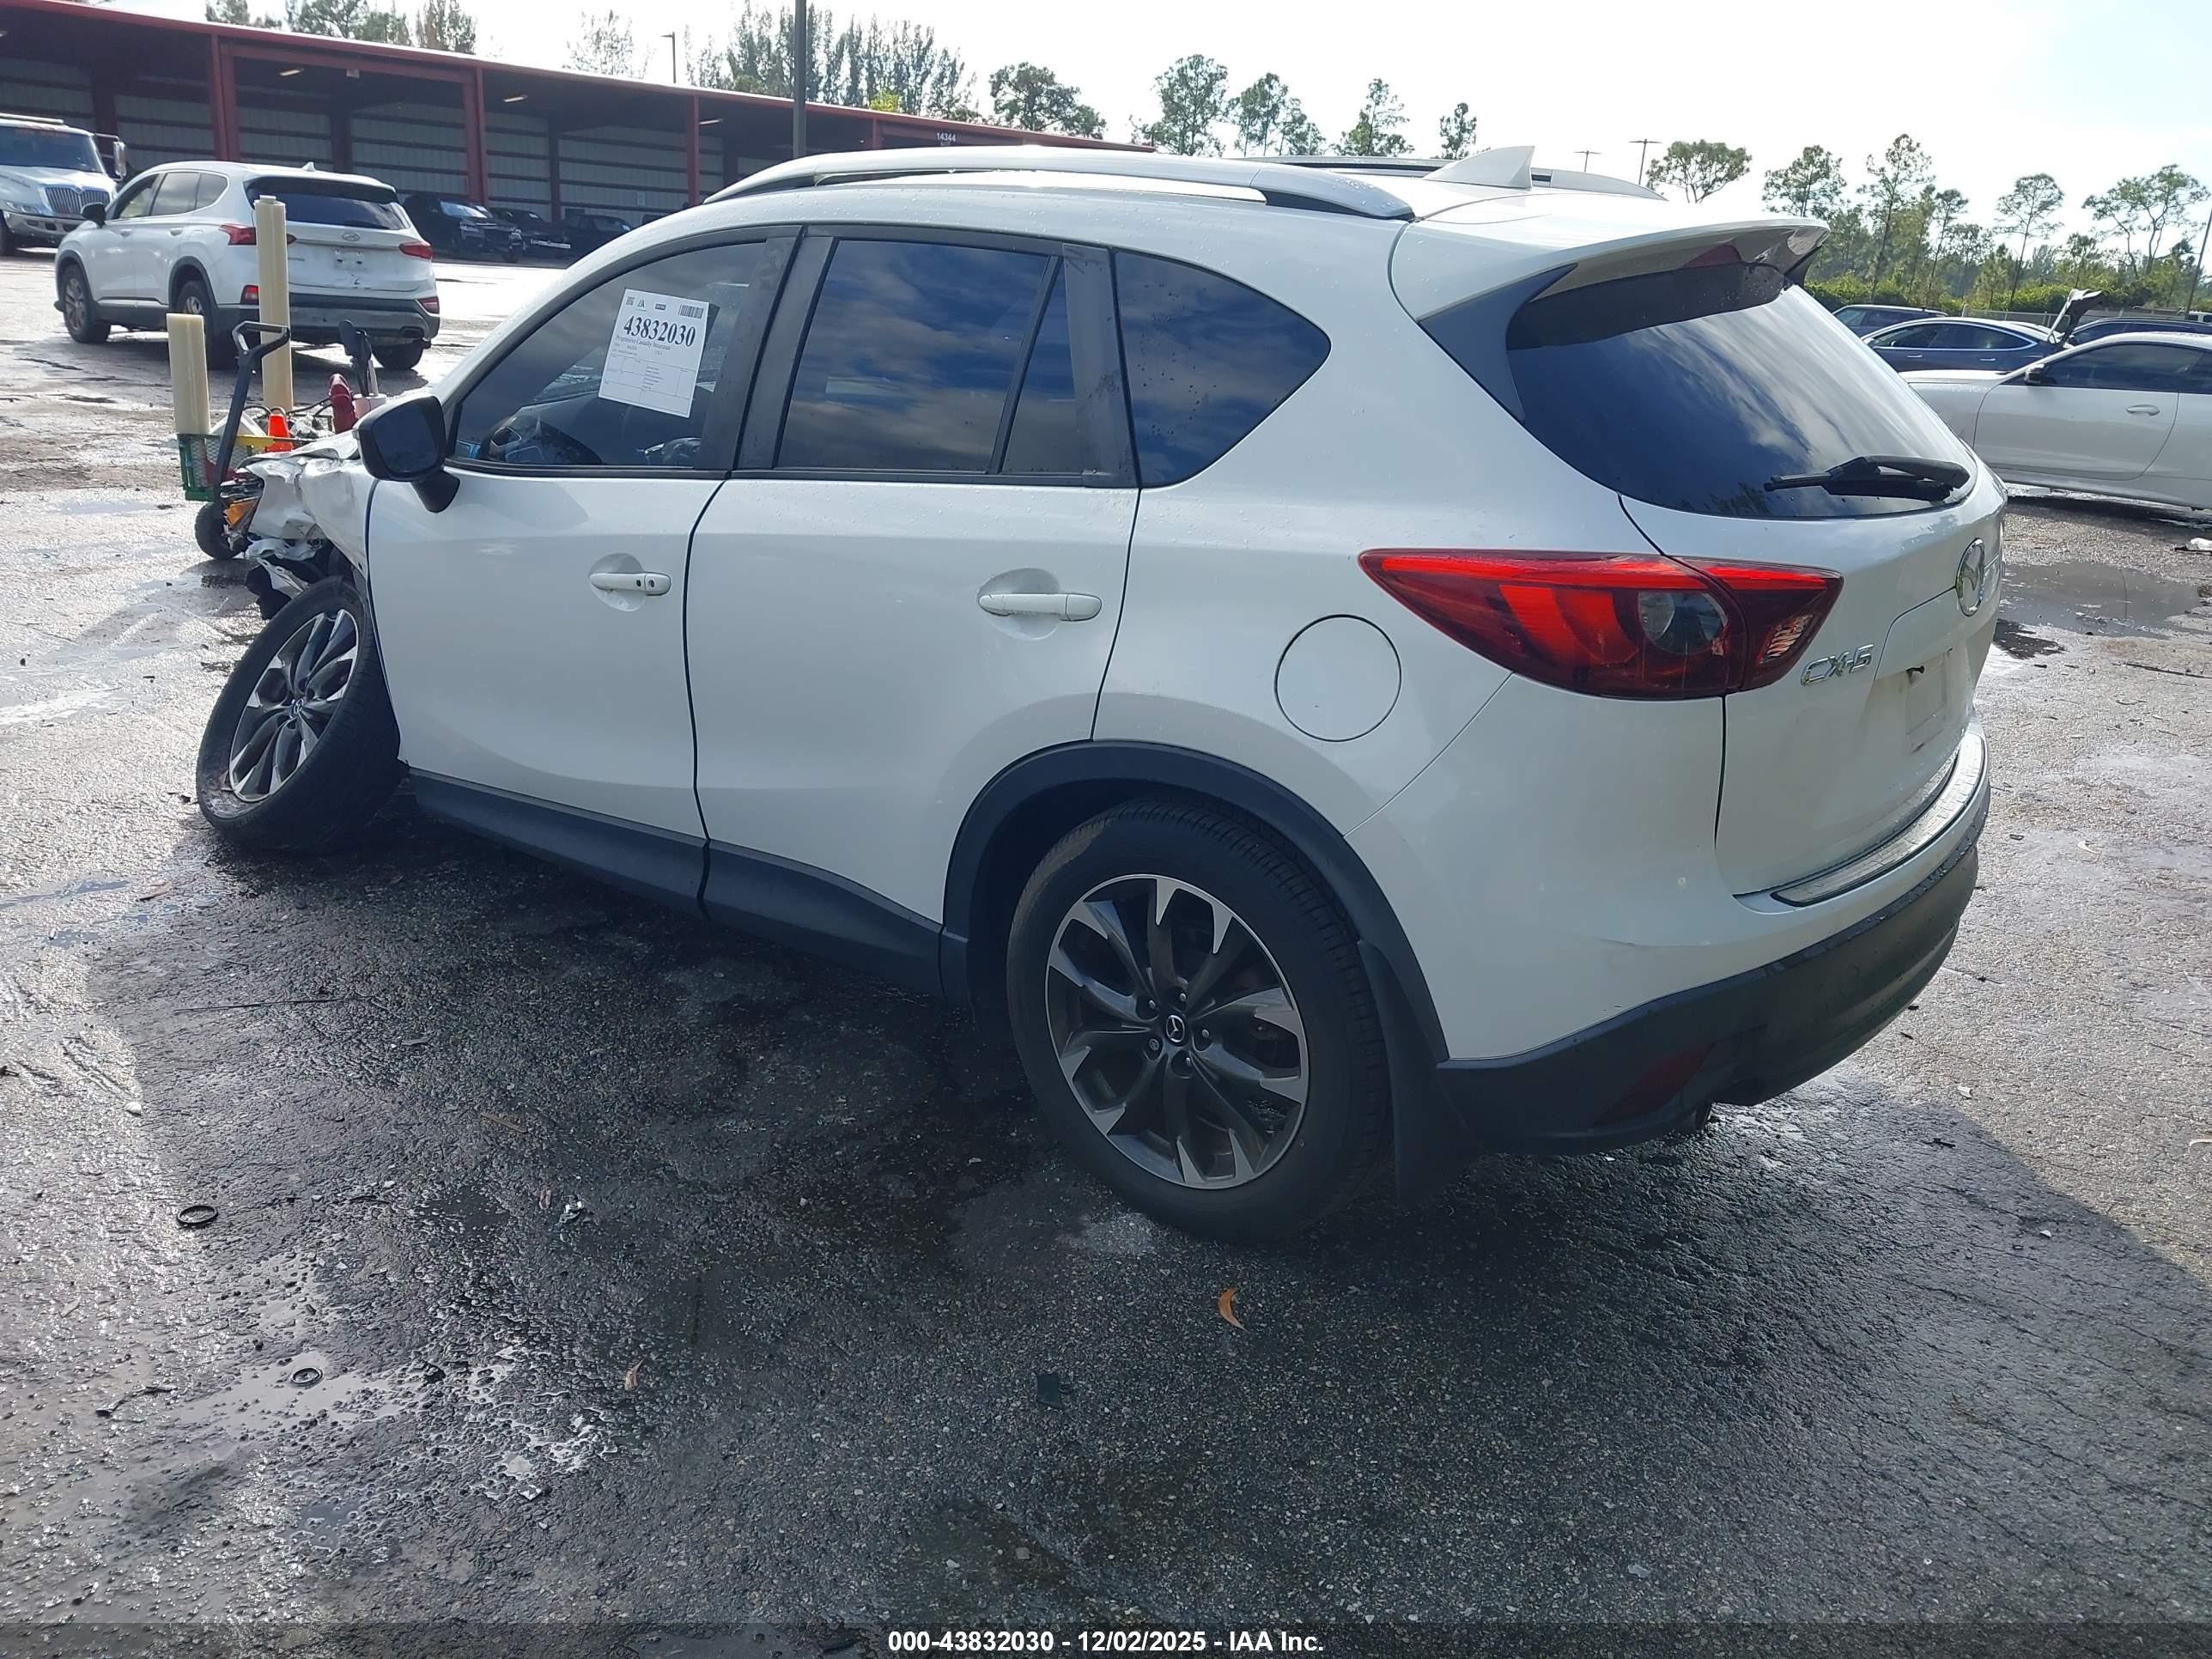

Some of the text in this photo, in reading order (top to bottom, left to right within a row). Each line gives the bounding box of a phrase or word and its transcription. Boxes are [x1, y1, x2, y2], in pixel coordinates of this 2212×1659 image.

[937, 132, 956, 143] 14344
[623, 315, 696, 347] 43832030
[1801, 644, 1875, 686] CX-5
